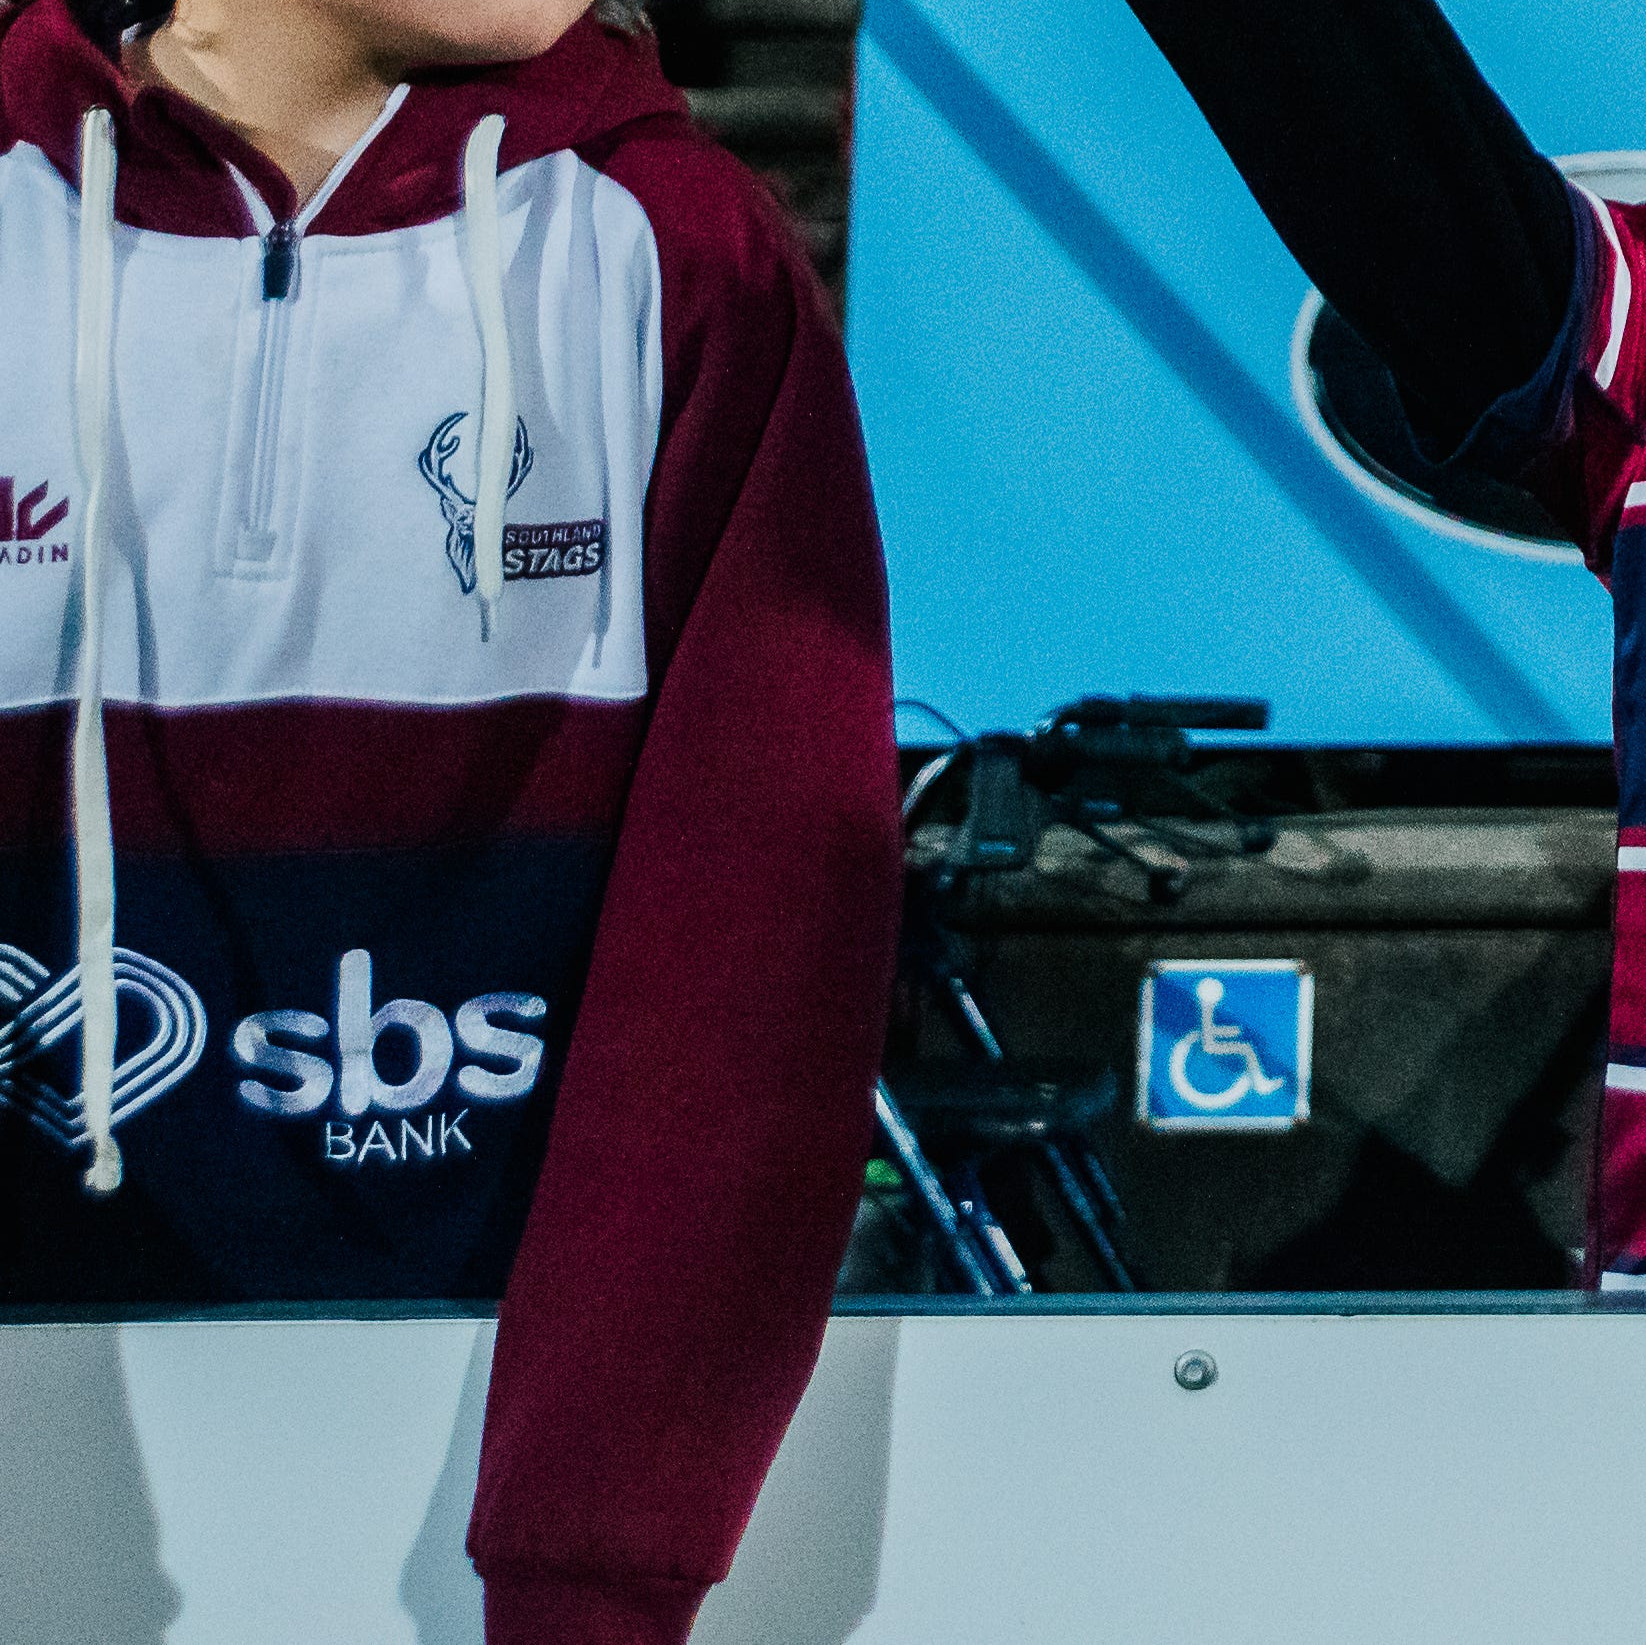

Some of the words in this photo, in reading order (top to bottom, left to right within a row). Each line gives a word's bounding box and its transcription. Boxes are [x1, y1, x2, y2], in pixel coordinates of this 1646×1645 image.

[505, 524, 601, 545] SOUTHLAND
[504, 541, 601, 573] STAGS
[233, 948, 547, 1116] sbs
[325, 1108, 472, 1163] BANK
